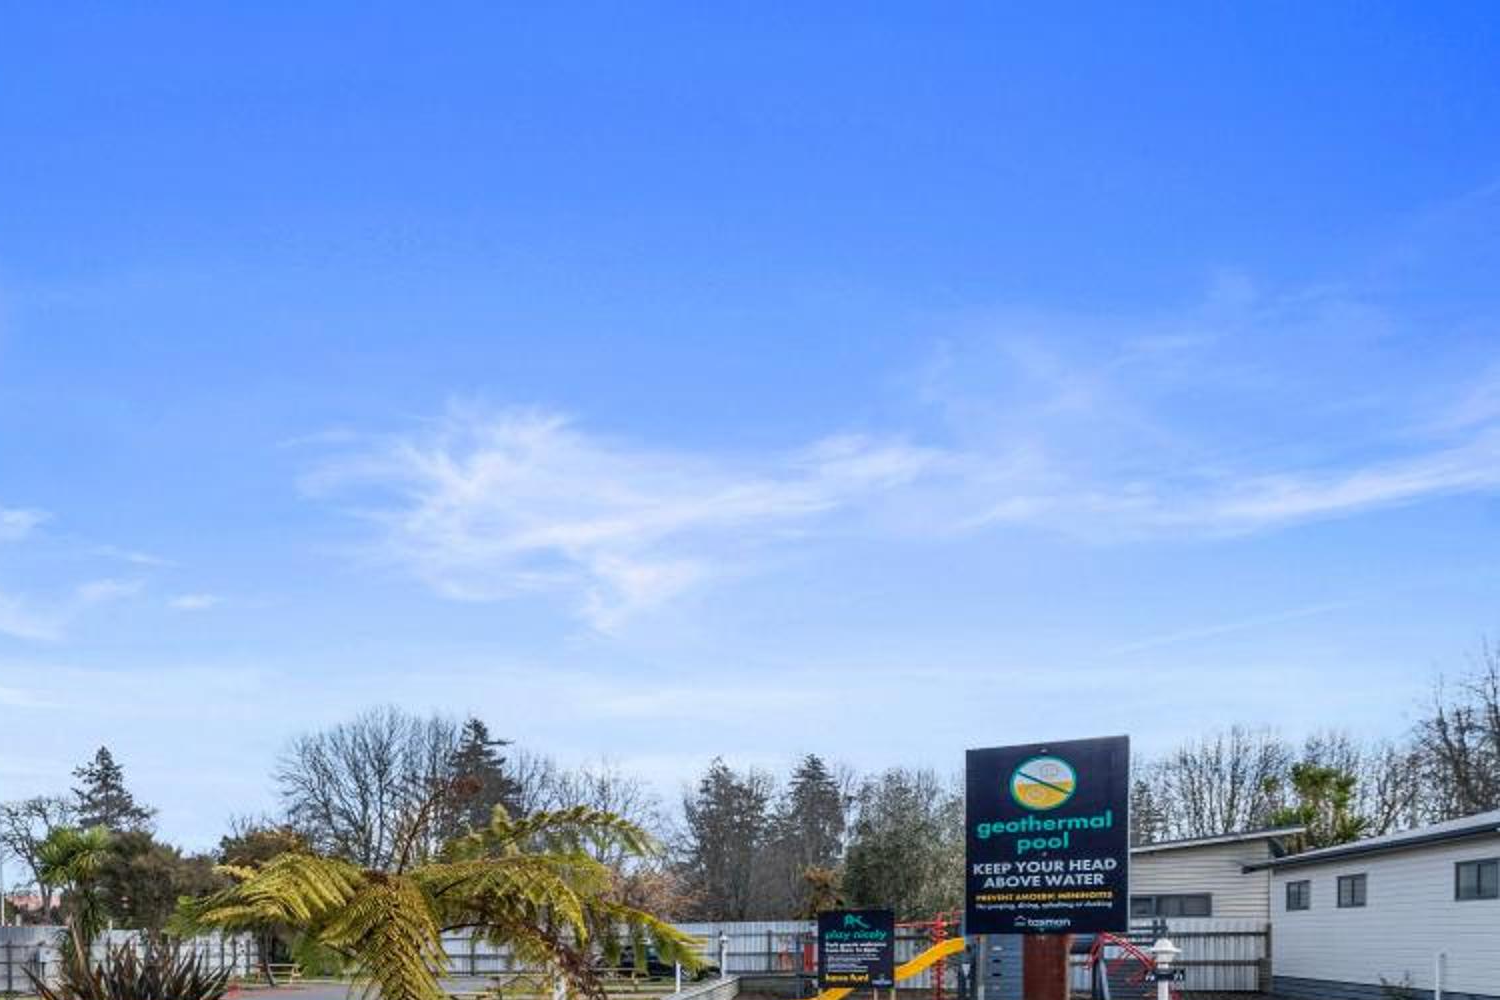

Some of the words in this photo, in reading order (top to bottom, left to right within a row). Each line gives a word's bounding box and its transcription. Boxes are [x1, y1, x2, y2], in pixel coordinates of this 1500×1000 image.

[977, 810, 1112, 838] geothermal
[1017, 831, 1069, 855] pool
[973, 863, 1012, 875] KEEP
[1015, 860, 1066, 873] YOUR
[1069, 858, 1117, 871] HEAD
[983, 875, 1041, 889] ABOVE
[1045, 873, 1104, 886] WATER
[1027, 918, 1071, 927] tasman
[826, 930, 850, 942] play
[853, 929, 887, 941] nicely
